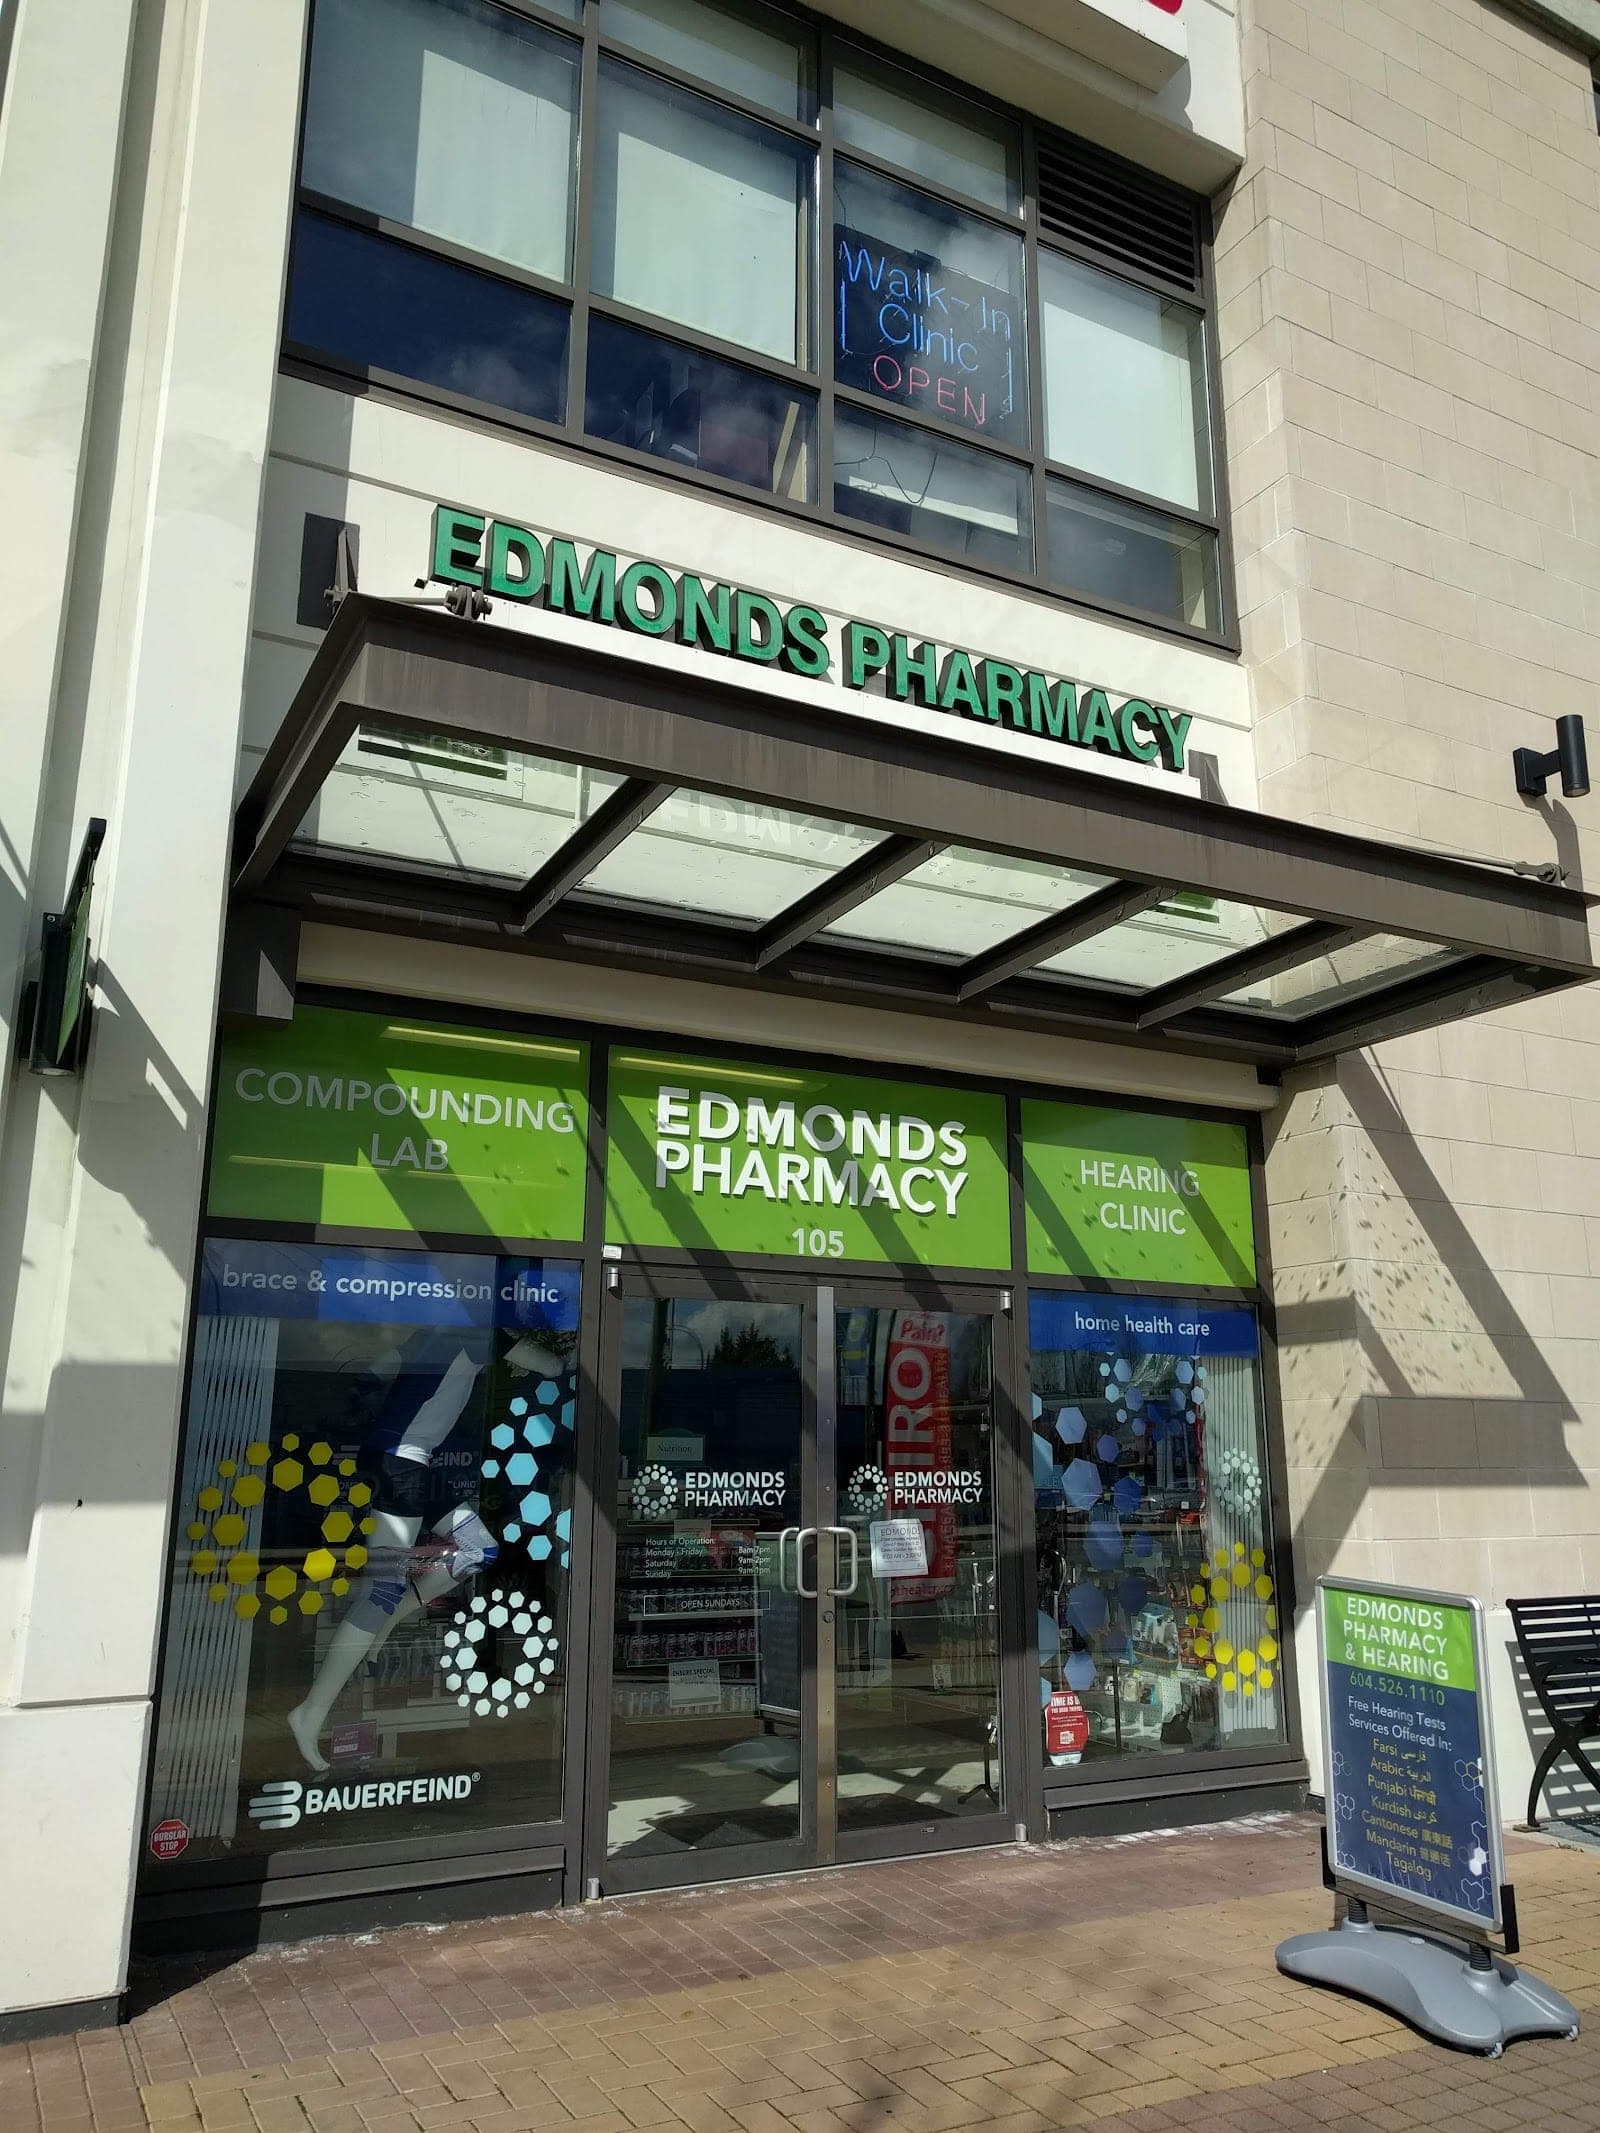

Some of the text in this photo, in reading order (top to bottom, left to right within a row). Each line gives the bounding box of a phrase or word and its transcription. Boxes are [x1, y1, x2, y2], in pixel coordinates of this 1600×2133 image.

[879, 304, 979, 372] Clinic
[873, 355, 986, 425] OPEN
[429, 504, 1194, 772] EDMONDS PHARMACY
[234, 1067, 576, 1133] COMPOUNDING
[657, 1085, 968, 1167] EDMONDS
[371, 1133, 449, 1171] LAB
[655, 1139, 969, 1216] PHARMACY
[1080, 1158, 1199, 1197] HEARING
[1100, 1202, 1187, 1235] CLINIC
[790, 1227, 845, 1257] 105
[222, 1263, 559, 1303] brace & compression clinic
[1075, 1311, 1210, 1336] home health care
[888, 1347, 937, 1570] HIRO
[685, 1471, 786, 1489] EDMONDS
[894, 1471, 982, 1487] EDMONDS
[684, 1489, 787, 1507] PHARMACY
[894, 1487, 983, 1505] PHARMACY
[645, 1538, 665, 1546] Hours
[645, 1549, 675, 1558] Monday
[681, 1547, 704, 1556] Friday
[645, 1560, 678, 1568] Saturday
[645, 1570, 672, 1578] Sunday
[681, 1599, 740, 1609] OPEN SUNDAYS
[1347, 1596, 1444, 1631] EDMONDS
[1343, 1619, 1448, 1656] PHARMACY
[1345, 1642, 1449, 1681] & HEARING
[1349, 1671, 1445, 1706] 604.526.1110
[1348, 1695, 1447, 1731] Free Hearing Tests
[1348, 1713, 1452, 1752] Services Offered In:
[1373, 1738, 1398, 1756] Farsi
[1370, 1757, 1405, 1777] Arabic
[1367, 1774, 1407, 1797] Punjabi
[1371, 1795, 1412, 1819] Kurdish
[153, 1829, 187, 1843] BURGLAR
[1361, 1809, 1419, 1837] Cantonese
[159, 1841, 179, 1851] STOP
[1366, 1829, 1417, 1856] Mandarin
[1385, 1851, 1432, 1882] Tagalog
